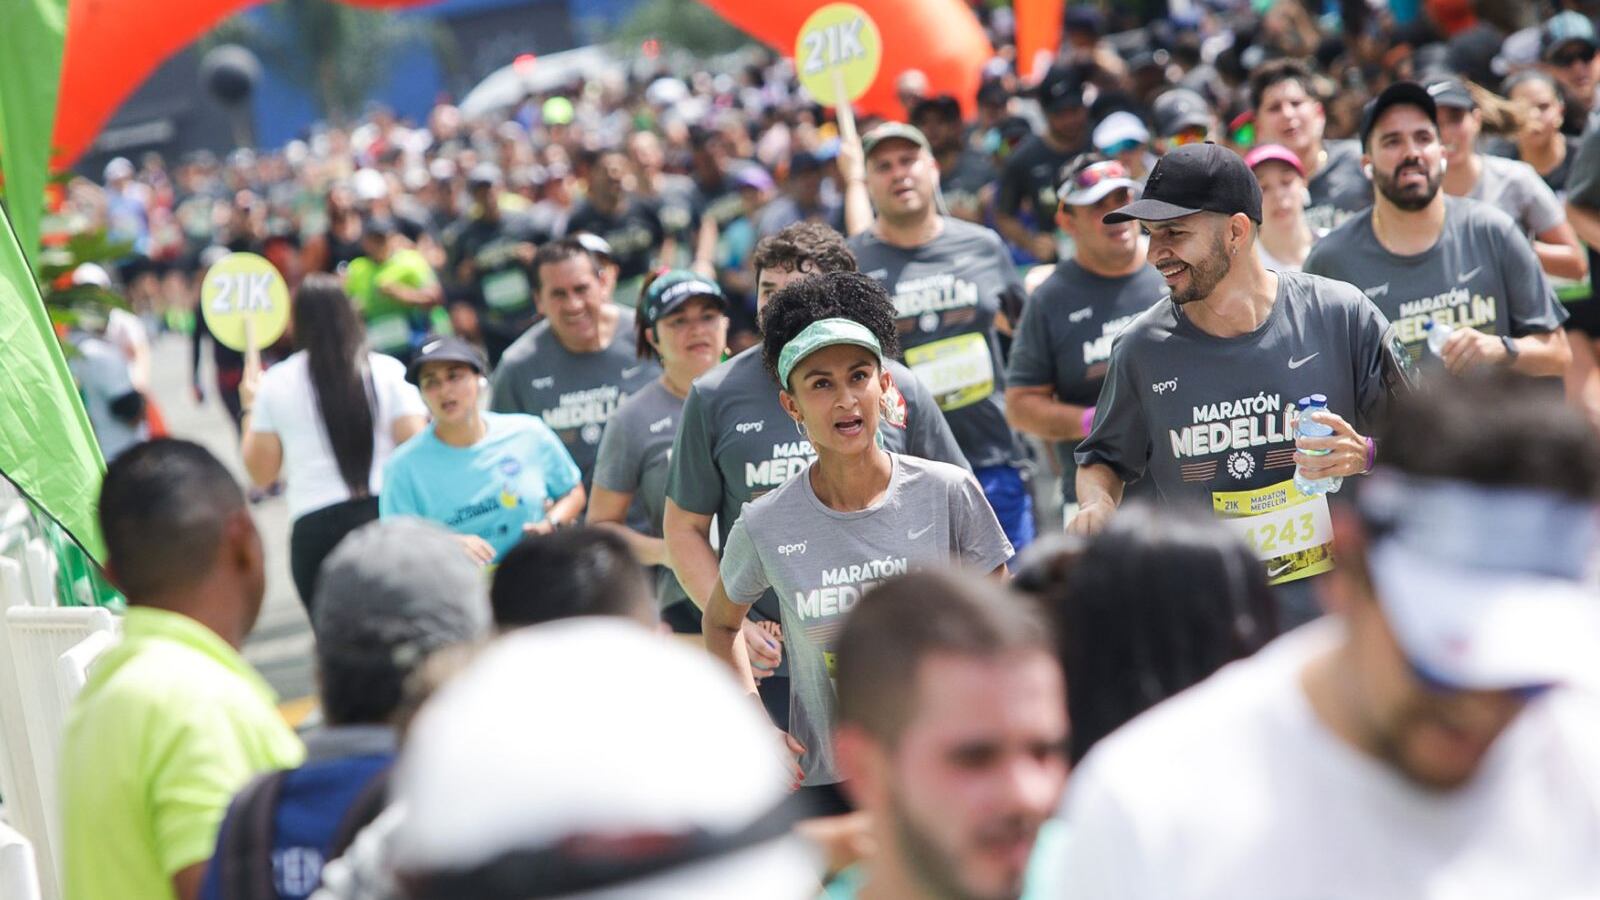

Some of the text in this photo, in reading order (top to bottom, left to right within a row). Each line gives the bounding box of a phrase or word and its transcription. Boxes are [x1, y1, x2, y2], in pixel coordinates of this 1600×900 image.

[803, 17, 865, 75] 21K
[211, 273, 273, 312] 21K
[1400, 287, 1470, 317] MARATÓN
[1152, 377, 1178, 395] epm
[1193, 391, 1280, 424] MARATÓN
[1225, 500, 1239, 511] 21K
[777, 540, 808, 556] epm
[821, 556, 907, 587] MARATÓN
